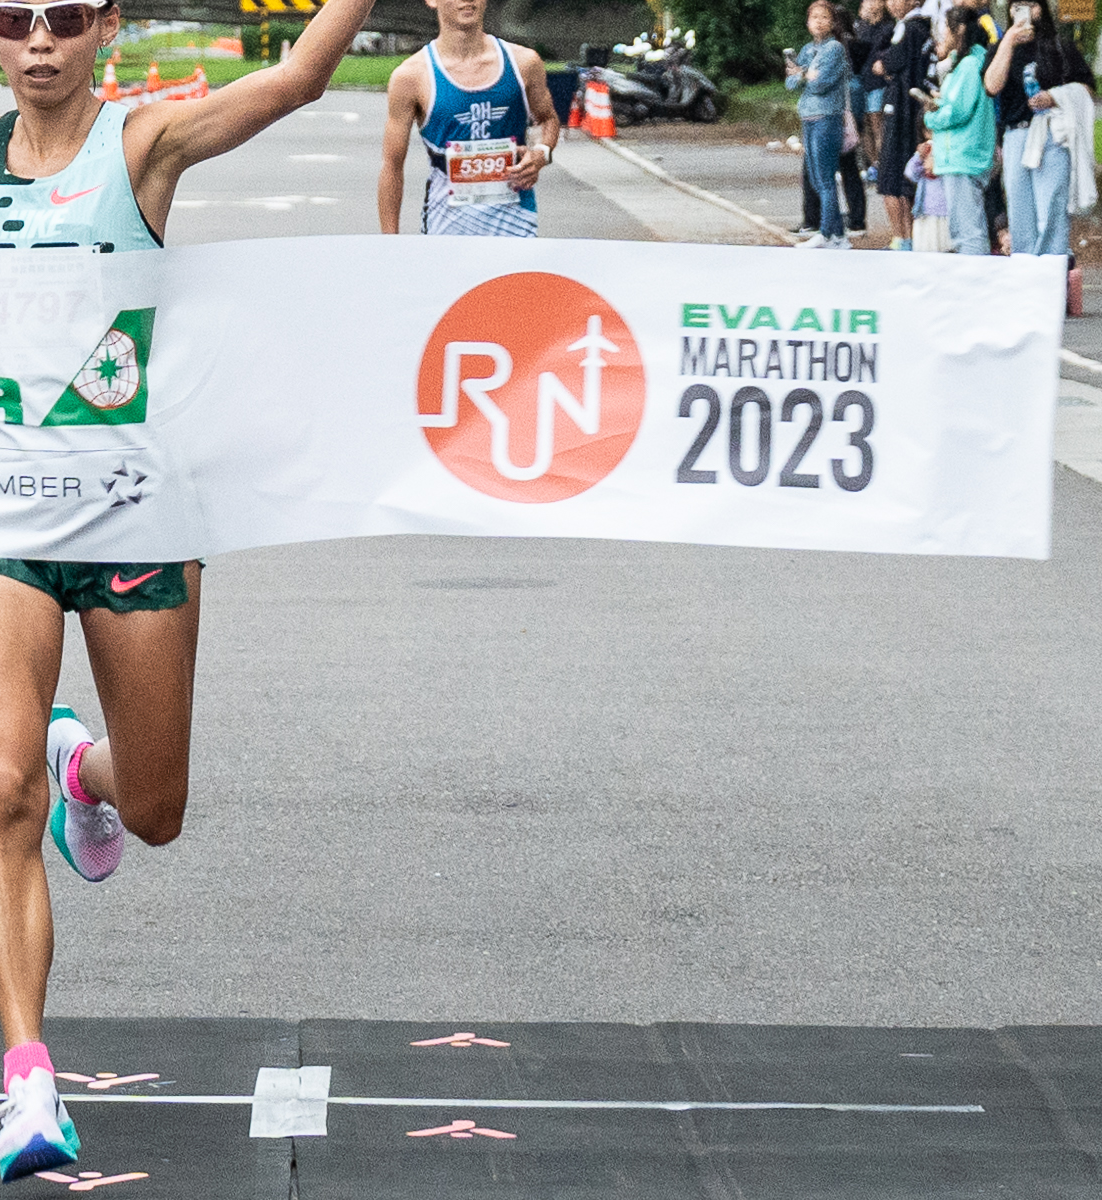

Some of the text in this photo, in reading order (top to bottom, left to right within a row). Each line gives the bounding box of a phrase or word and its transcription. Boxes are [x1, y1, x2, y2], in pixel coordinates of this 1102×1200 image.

[460, 156, 506, 176] 5399
[0, 208, 69, 240] NIKE
[679, 336, 879, 384] MARATHON
[675, 384, 875, 493] 2023
